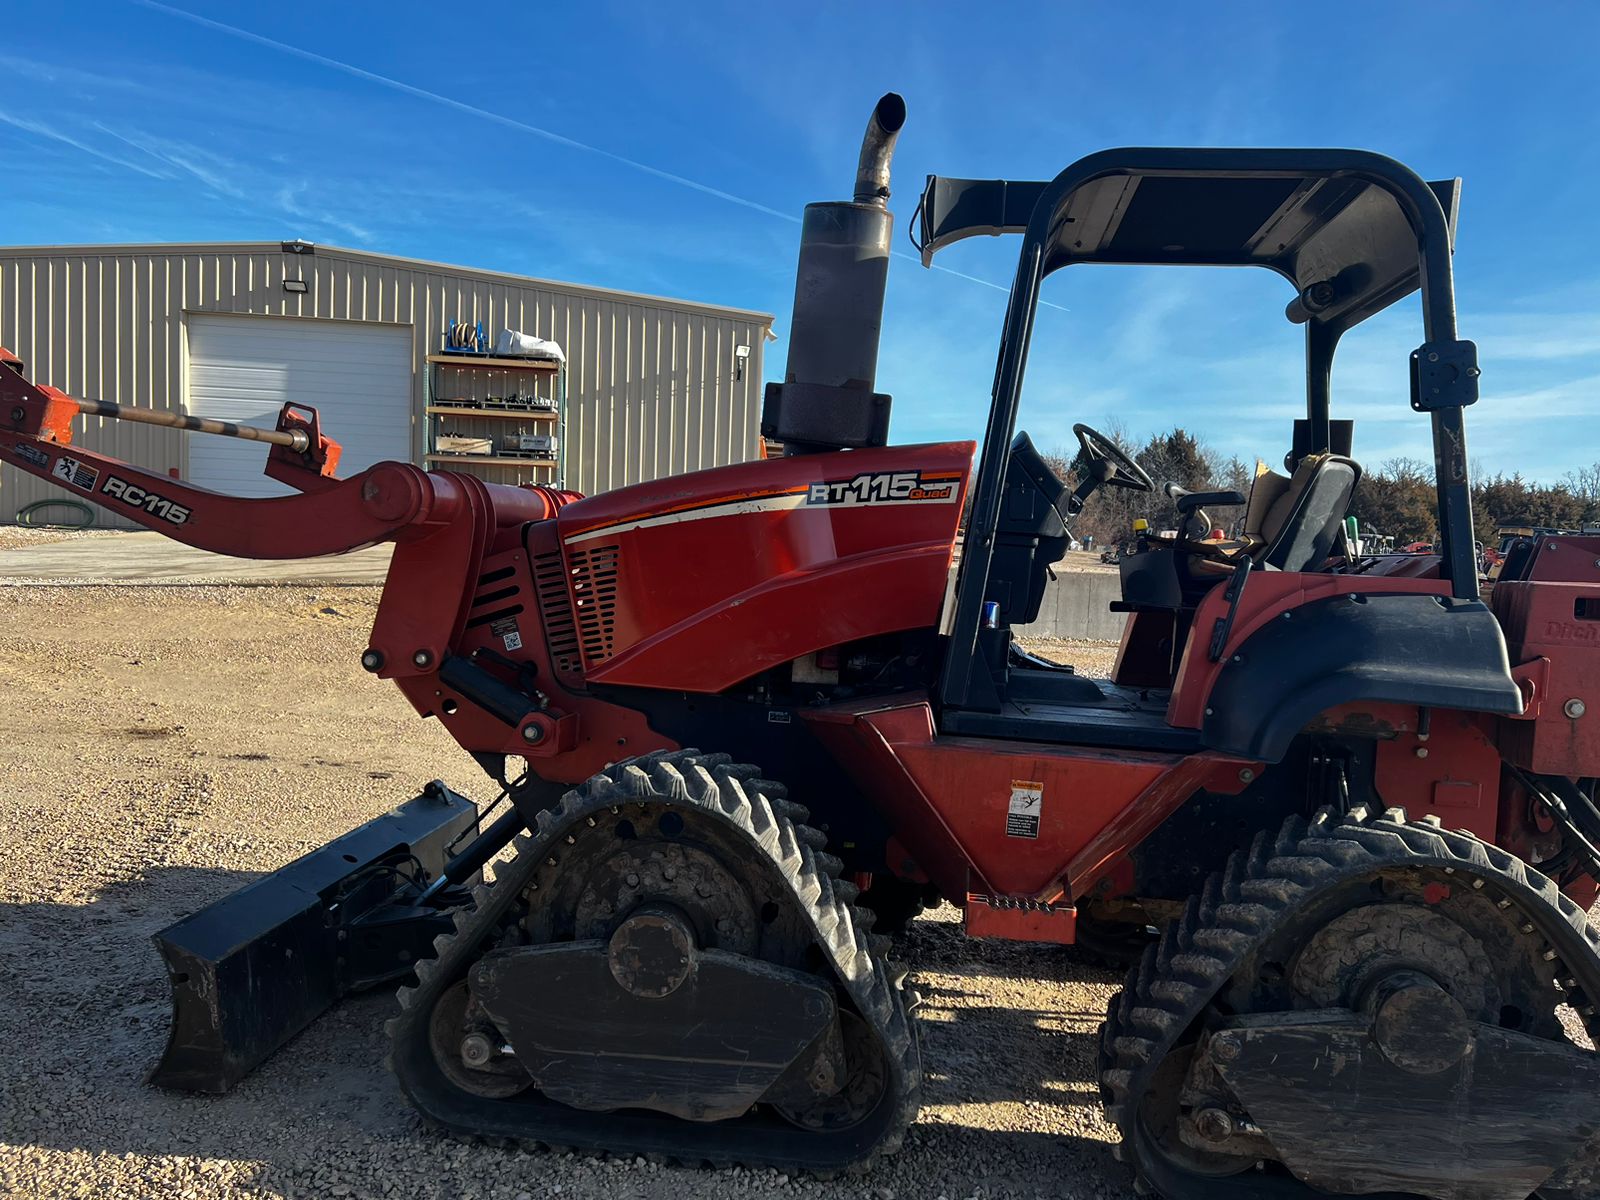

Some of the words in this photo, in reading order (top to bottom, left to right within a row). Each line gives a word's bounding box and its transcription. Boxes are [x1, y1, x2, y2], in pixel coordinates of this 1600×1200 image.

[102, 476, 190, 524] RC115
[909, 487, 951, 500] Quad
[1544, 621, 1598, 640] Ditch
